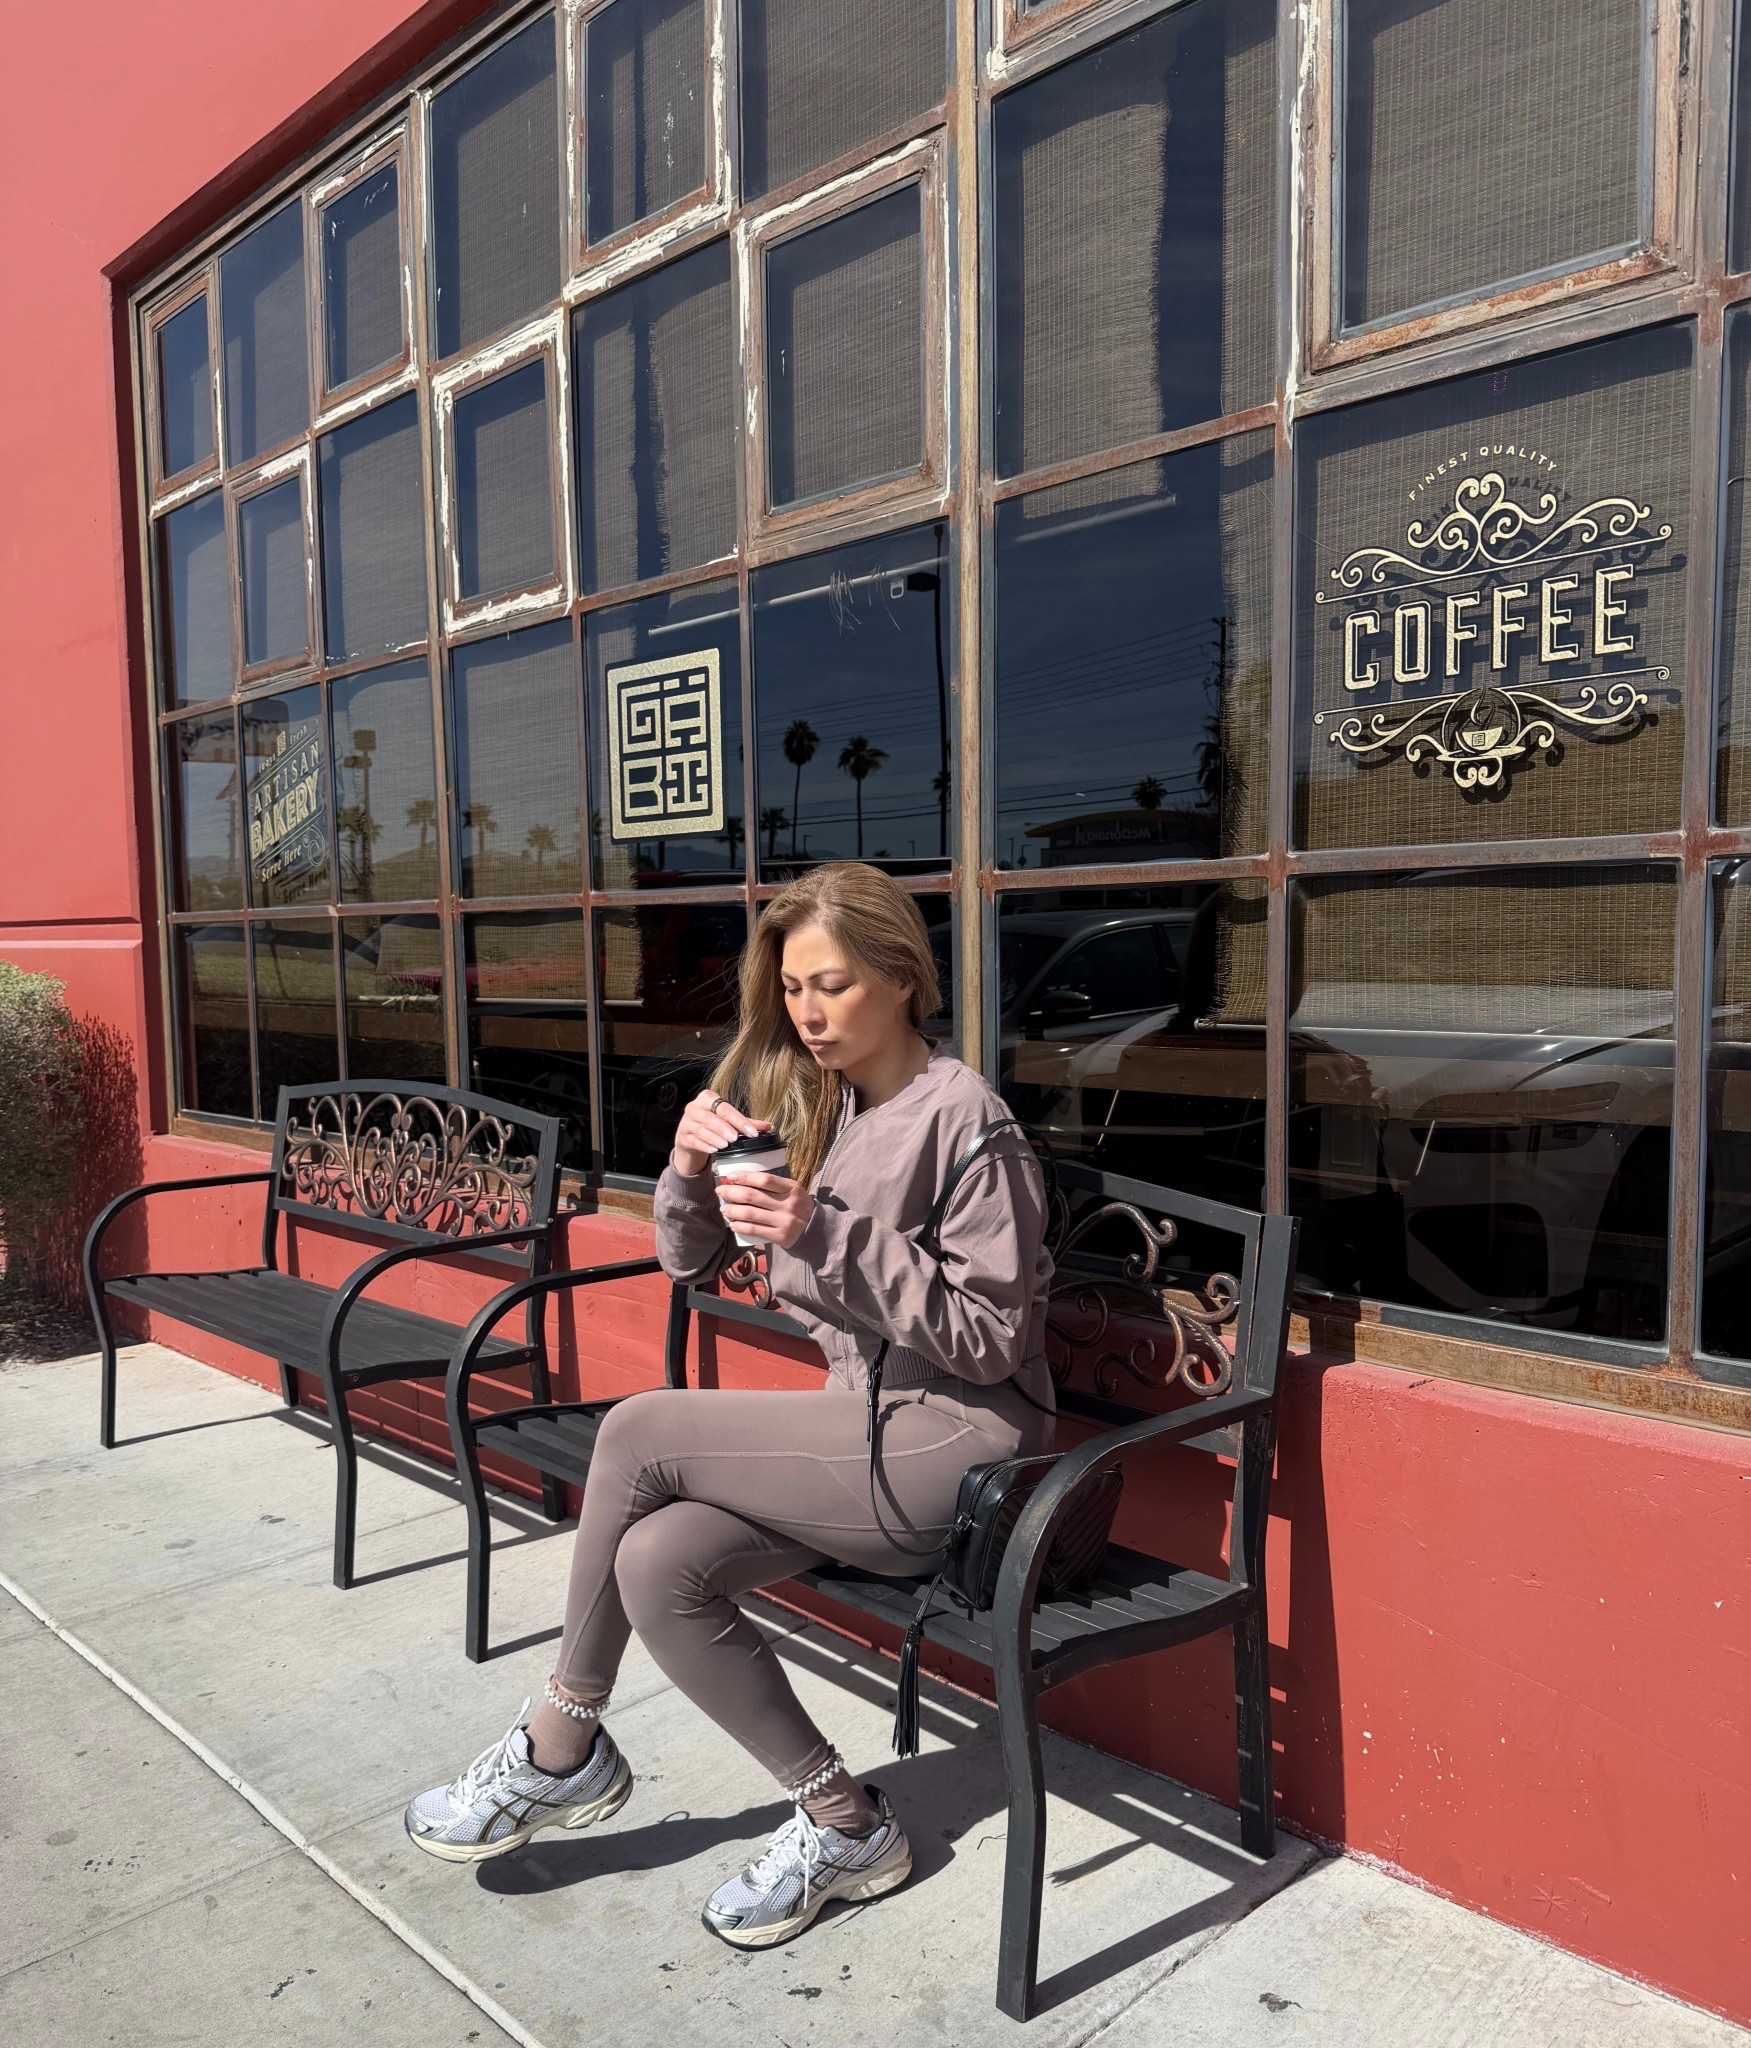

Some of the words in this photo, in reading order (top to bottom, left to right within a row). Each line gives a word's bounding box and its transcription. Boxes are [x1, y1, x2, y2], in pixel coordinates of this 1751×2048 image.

[1408, 451, 1470, 501] FINEST
[1479, 444, 1558, 473] QUALITY
[1343, 564, 1635, 691] COFFEE
[251, 768, 320, 862] BAKERY
[254, 741, 320, 816] ARTISAN
[261, 858, 282, 883] Serve
[284, 844, 302, 867] Here
